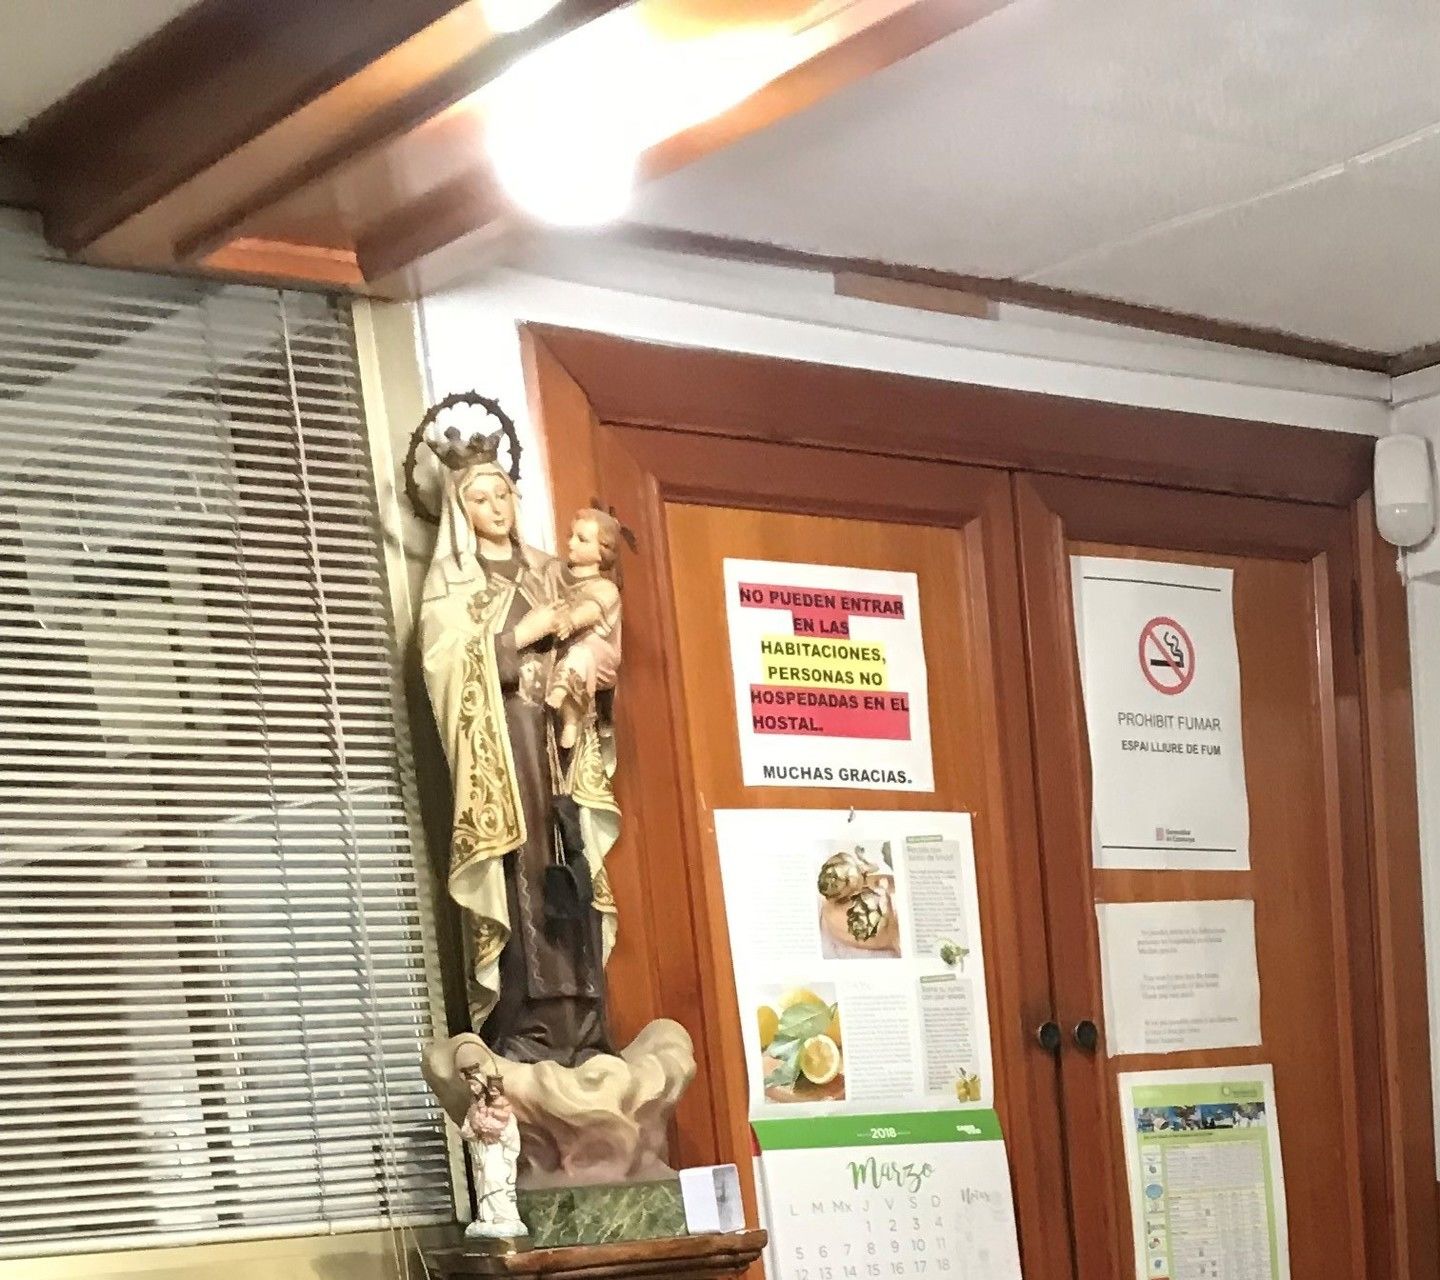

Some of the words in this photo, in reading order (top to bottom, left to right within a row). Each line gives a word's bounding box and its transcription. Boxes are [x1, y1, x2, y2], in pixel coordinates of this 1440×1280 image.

[740, 588, 763, 603] NO
[769, 591, 835, 608] PUEDEN
[842, 597, 904, 615] ENTRAR
[794, 618, 814, 632] EN
[820, 620, 849, 634] LAS
[761, 641, 886, 664] HABITACIONES,
[768, 667, 854, 684] PERSONAS
[860, 673, 882, 686] NO
[752, 690, 858, 709] HOSPEDADAS
[864, 697, 885, 711] EN
[891, 698, 908, 712] EL
[753, 716, 823, 731] HOSTAL.
[1118, 712, 1173, 728] PROHIBIT
[1178, 716, 1221, 731] FUMAR
[1122, 740, 1148, 751] ESPAI
[1152, 743, 1182, 753] LLIURE
[1187, 744, 1198, 754] DE
[1202, 745, 1220, 755] FUM
[764, 765, 833, 780] MUCHAS
[839, 768, 912, 784] GRACIAS.
[871, 1128, 897, 1138] 2018
[849, 1157, 935, 1193] Marzo
[866, 1220, 871, 1232] 1
[889, 1220, 896, 1231] 2
[913, 1218, 920, 1230] 3
[935, 1216, 943, 1227] 4
[796, 1247, 804, 1260] 5
[819, 1246, 827, 1258] 6
[844, 1244, 850, 1255] 7
[868, 1242, 875, 1254] 8
[891, 1240, 899, 1253] 9
[912, 1239, 925, 1251] 10
[937, 1238, 945, 1248] 11
[819, 1268, 832, 1280] 13
[844, 1266, 856, 1277] 14
[867, 1264, 880, 1275] 15
[890, 1262, 904, 1274] 16
[914, 1260, 926, 1272] 17
[937, 1259, 950, 1271] 18
